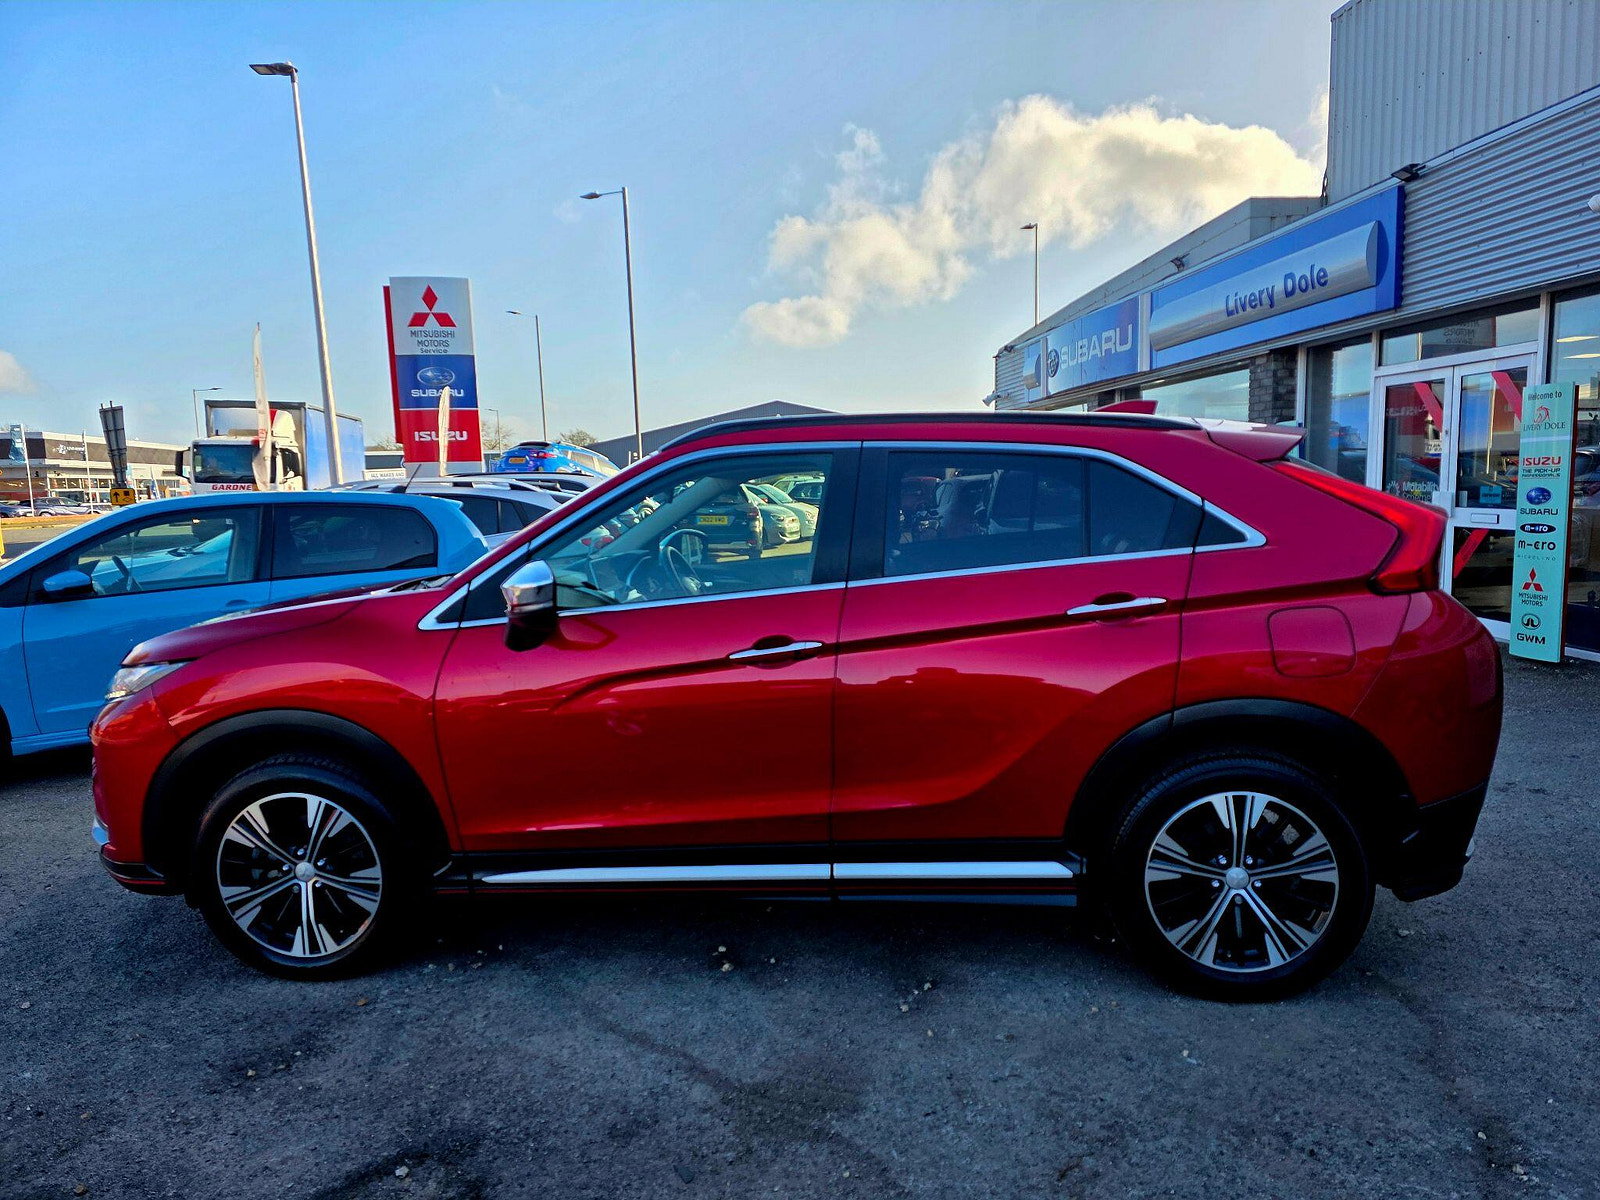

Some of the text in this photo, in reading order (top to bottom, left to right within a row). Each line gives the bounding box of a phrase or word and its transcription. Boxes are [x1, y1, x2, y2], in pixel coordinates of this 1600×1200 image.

[1225, 264, 1329, 318] Livery Dole
[410, 330, 455, 338] MITSUBISHI
[417, 339, 450, 348] MOTORS
[1060, 323, 1133, 370] SUBARU
[1527, 390, 1563, 401] Welcome to
[1544, 421, 1566, 430] DOLE
[1522, 456, 1561, 466] ISUZU
[1520, 507, 1559, 516] SUBARU
[1518, 592, 1549, 601] MITSUBISHI
[1521, 599, 1543, 607] MOTORS
[1516, 632, 1546, 645] GWM
